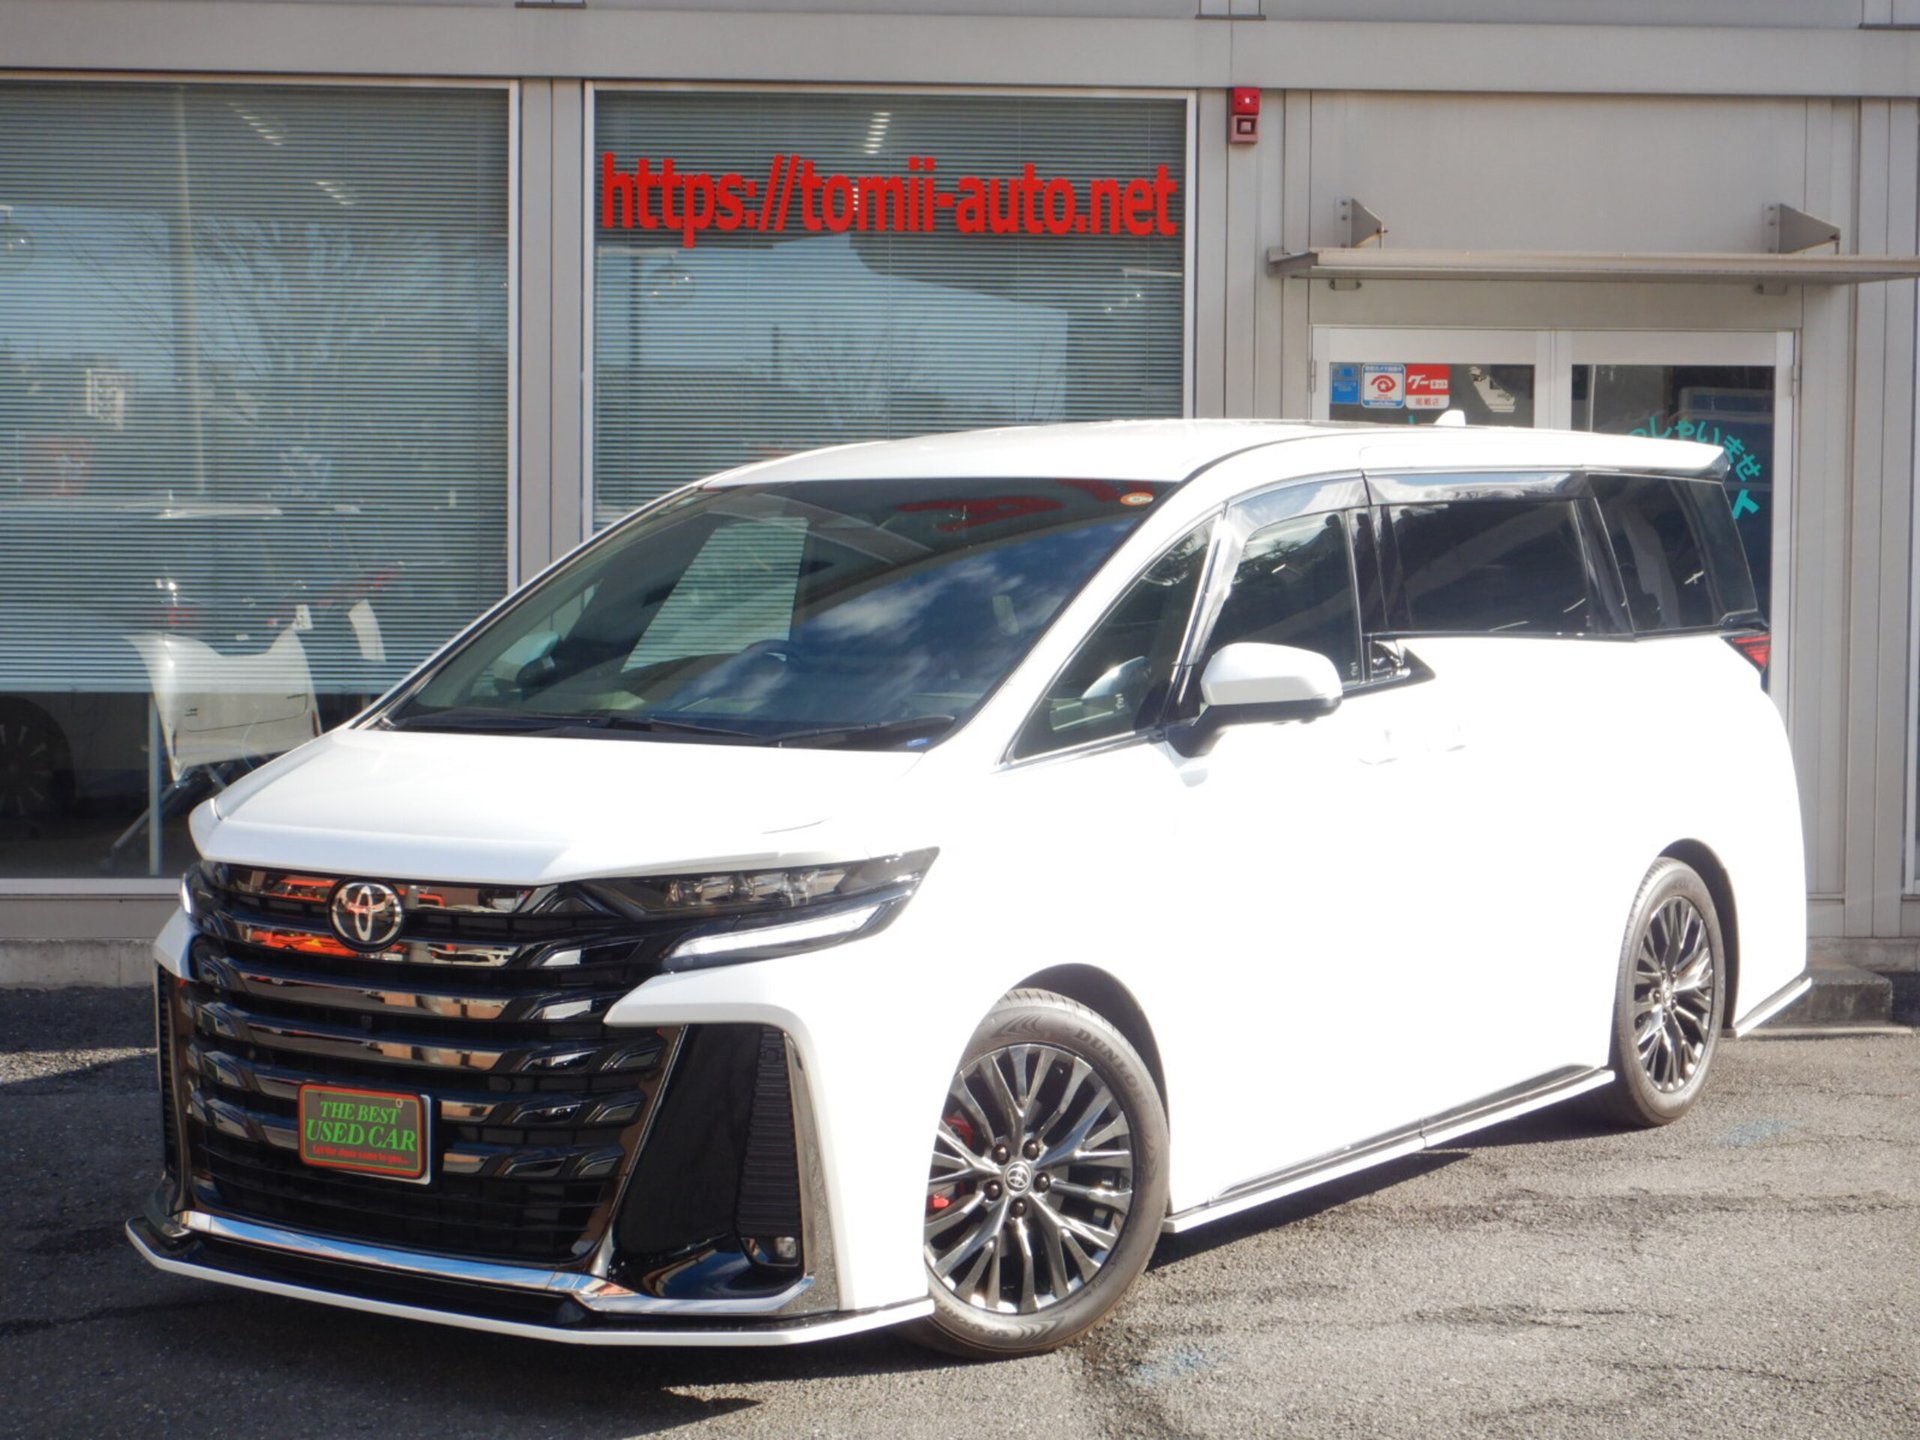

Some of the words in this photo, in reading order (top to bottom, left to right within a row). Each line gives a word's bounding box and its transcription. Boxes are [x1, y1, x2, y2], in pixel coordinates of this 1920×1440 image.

[602, 152, 1177, 248] https://tomii-auto.net
[320, 1102, 355, 1119] THE
[357, 1105, 401, 1125] BEST
[307, 1119, 365, 1145] USED
[368, 1126, 416, 1151] CAR
